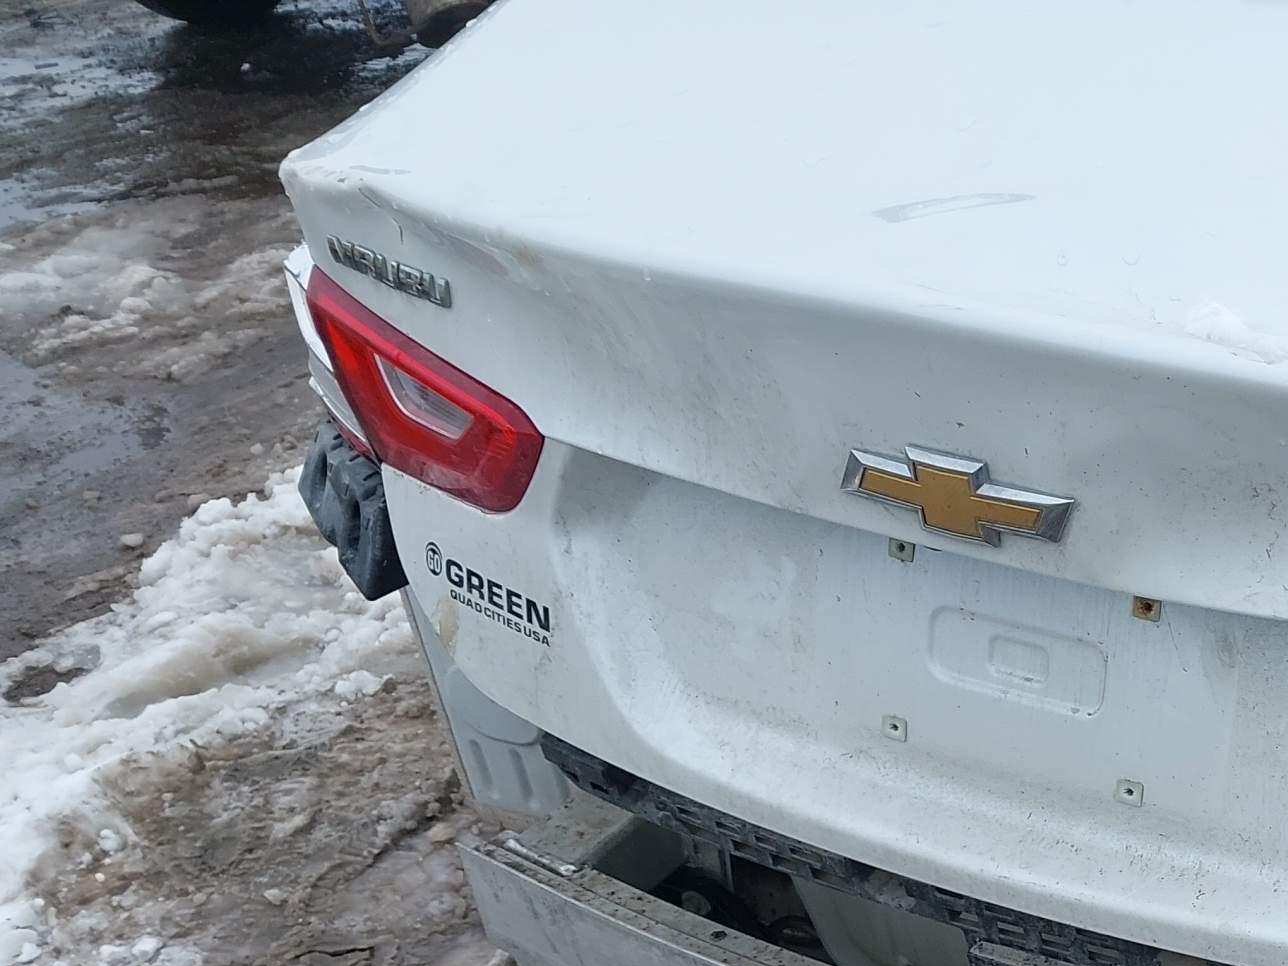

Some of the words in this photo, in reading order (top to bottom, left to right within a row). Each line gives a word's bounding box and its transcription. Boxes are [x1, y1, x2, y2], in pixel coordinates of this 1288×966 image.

[446, 559, 550, 632] GREEN
[450, 589, 482, 613] QUAD
[484, 607, 521, 632] CITIES
[523, 625, 550, 647] USA
